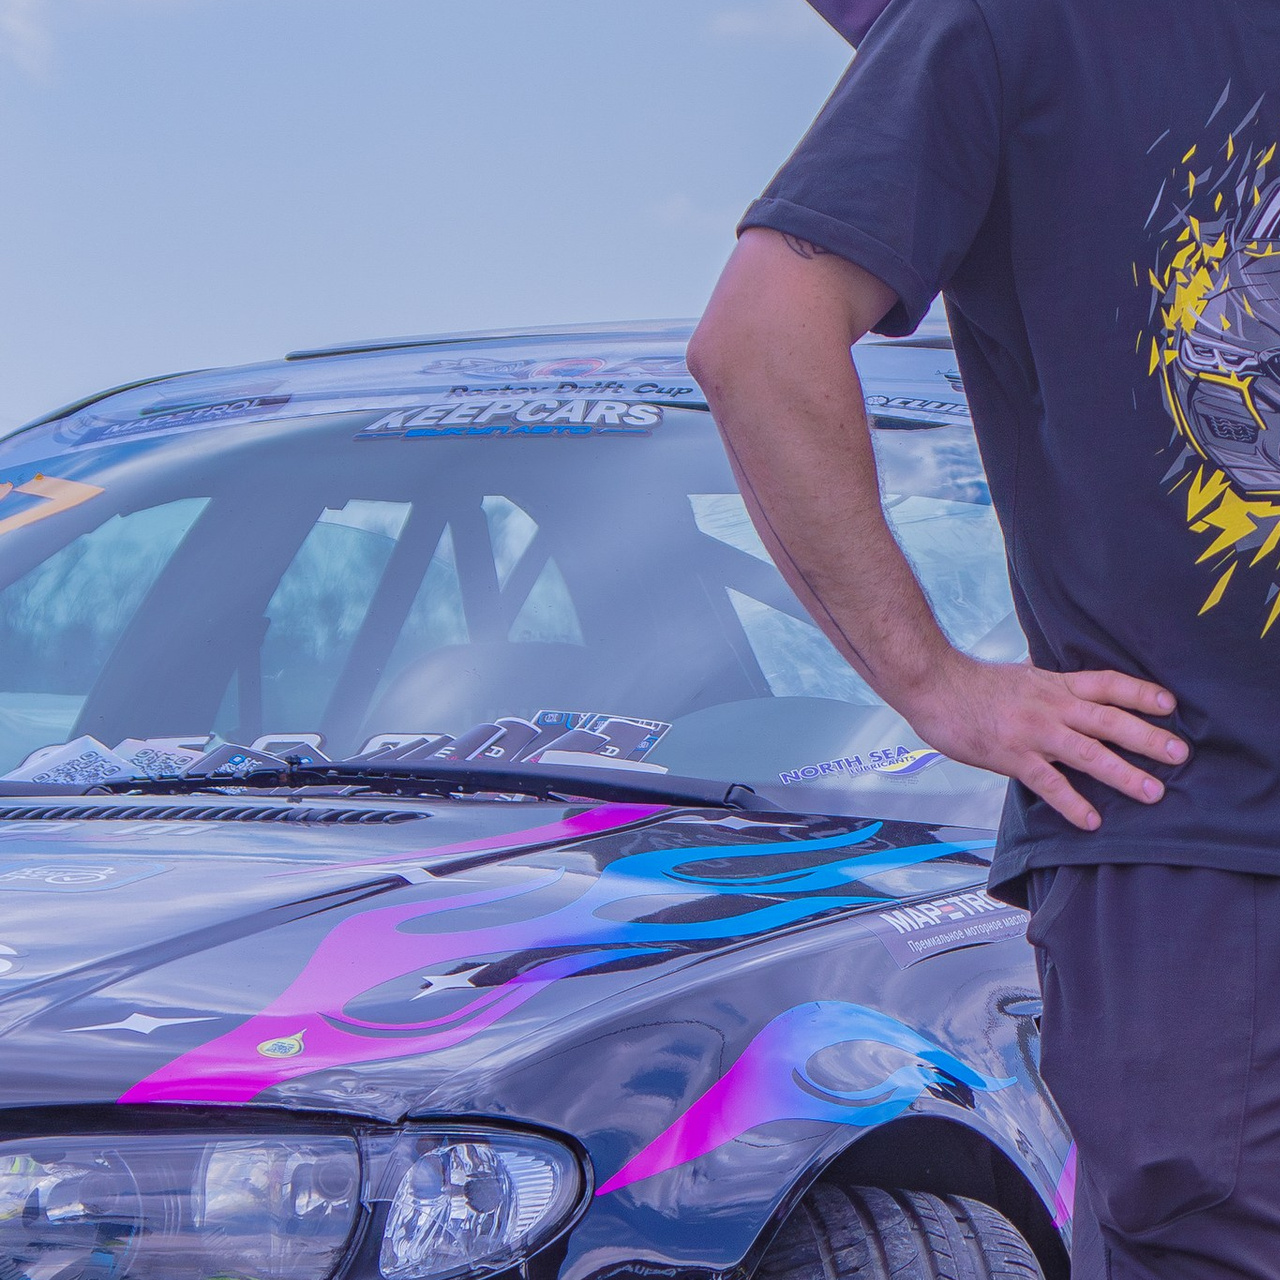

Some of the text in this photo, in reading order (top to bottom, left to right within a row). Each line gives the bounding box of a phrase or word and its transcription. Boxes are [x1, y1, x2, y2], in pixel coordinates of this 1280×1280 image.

[444, 380, 695, 399] Rostov Drift Cup
[362, 399, 664, 433] KEEPCARS
[778, 754, 864, 785] NORTH
[868, 744, 912, 763] SEA
[849, 755, 917, 776] LUBRICANTS
[907, 913, 1029, 955] Премиальное моторное масло
